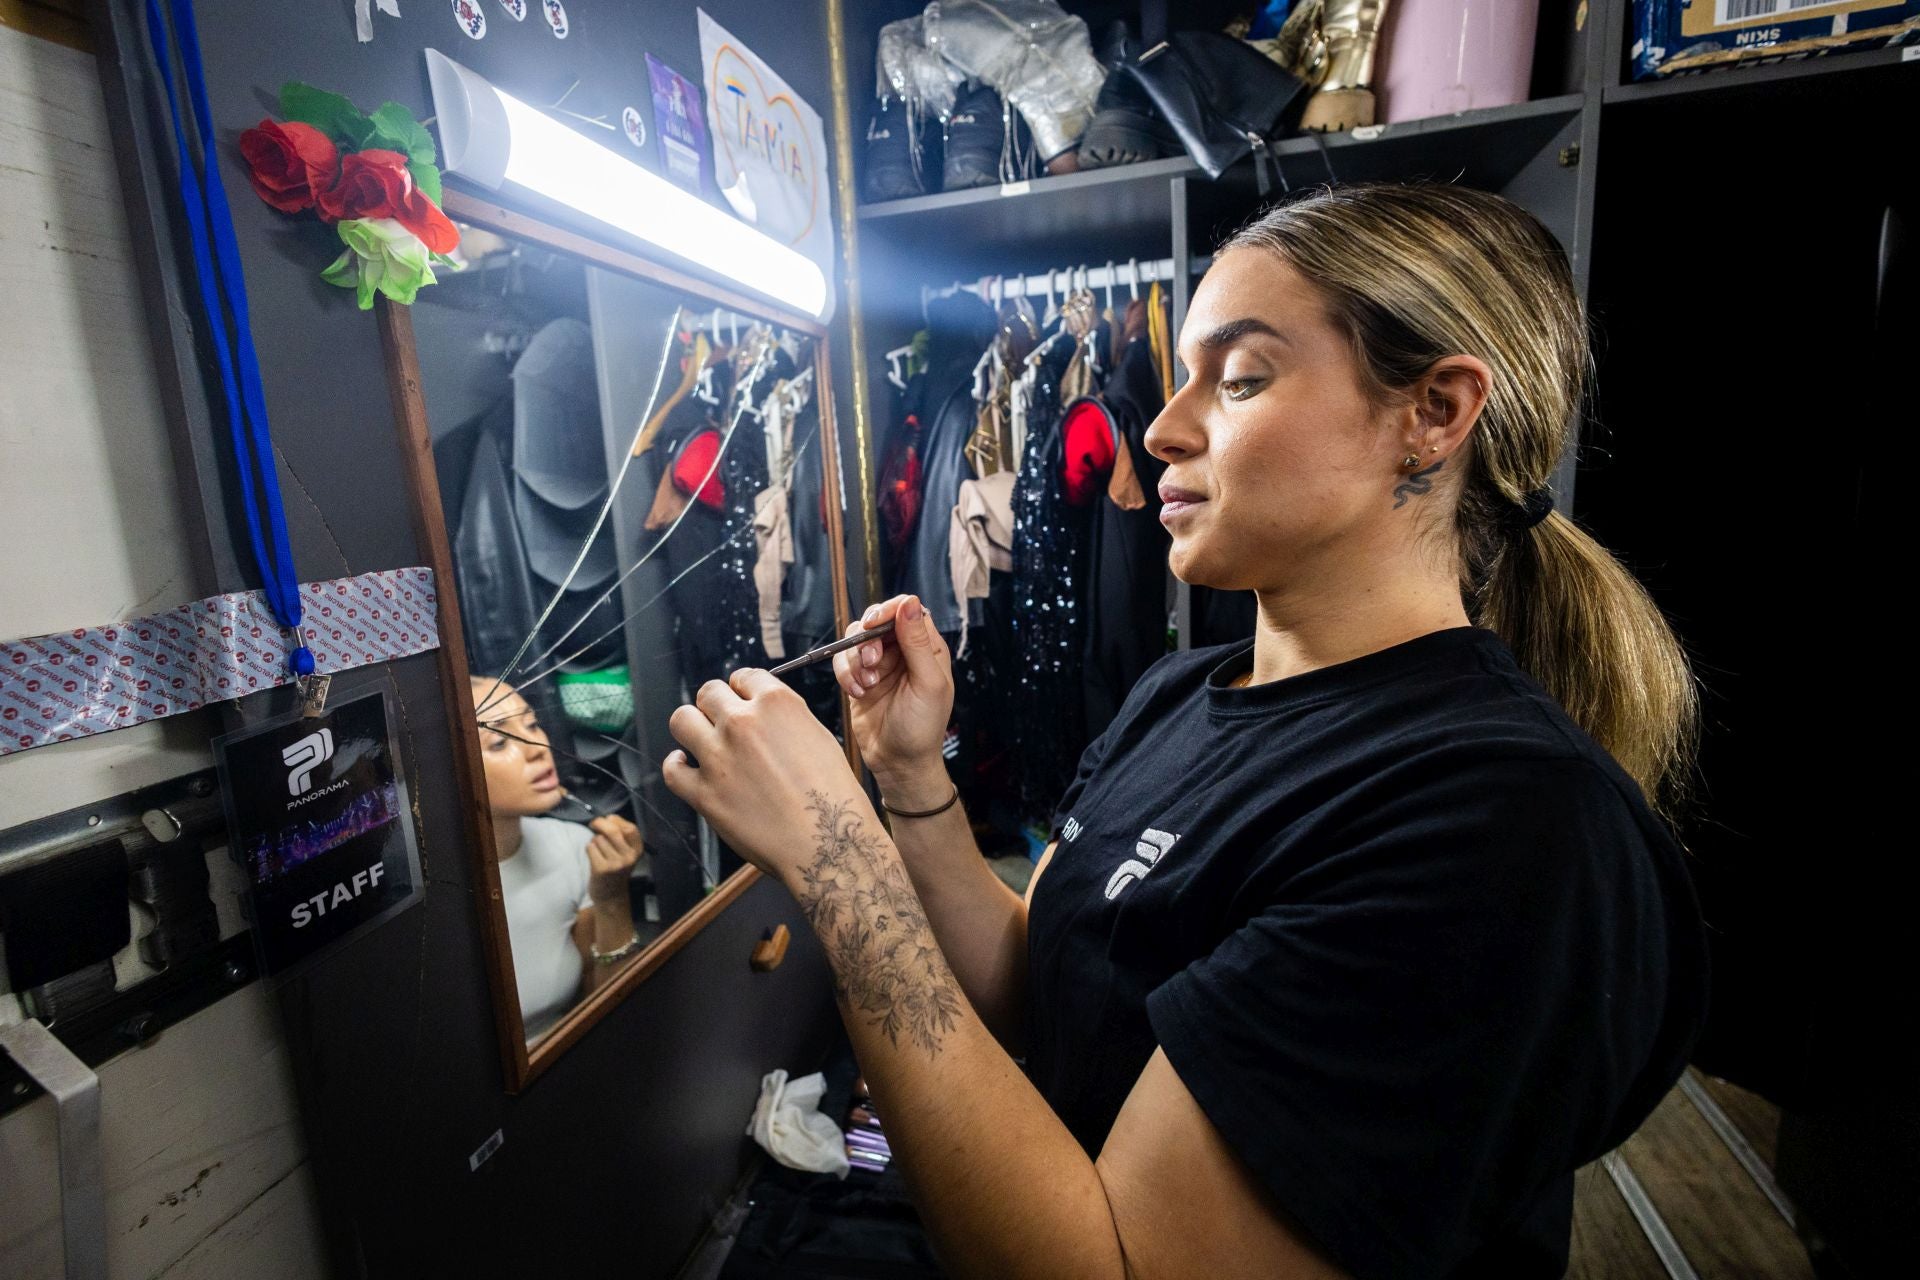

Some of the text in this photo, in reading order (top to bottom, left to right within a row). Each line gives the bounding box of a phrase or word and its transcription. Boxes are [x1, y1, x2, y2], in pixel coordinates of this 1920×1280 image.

[1736, 28, 1781, 45] SKIN
[287, 780, 349, 810] PANORAMA
[291, 861, 385, 929] STAFF
